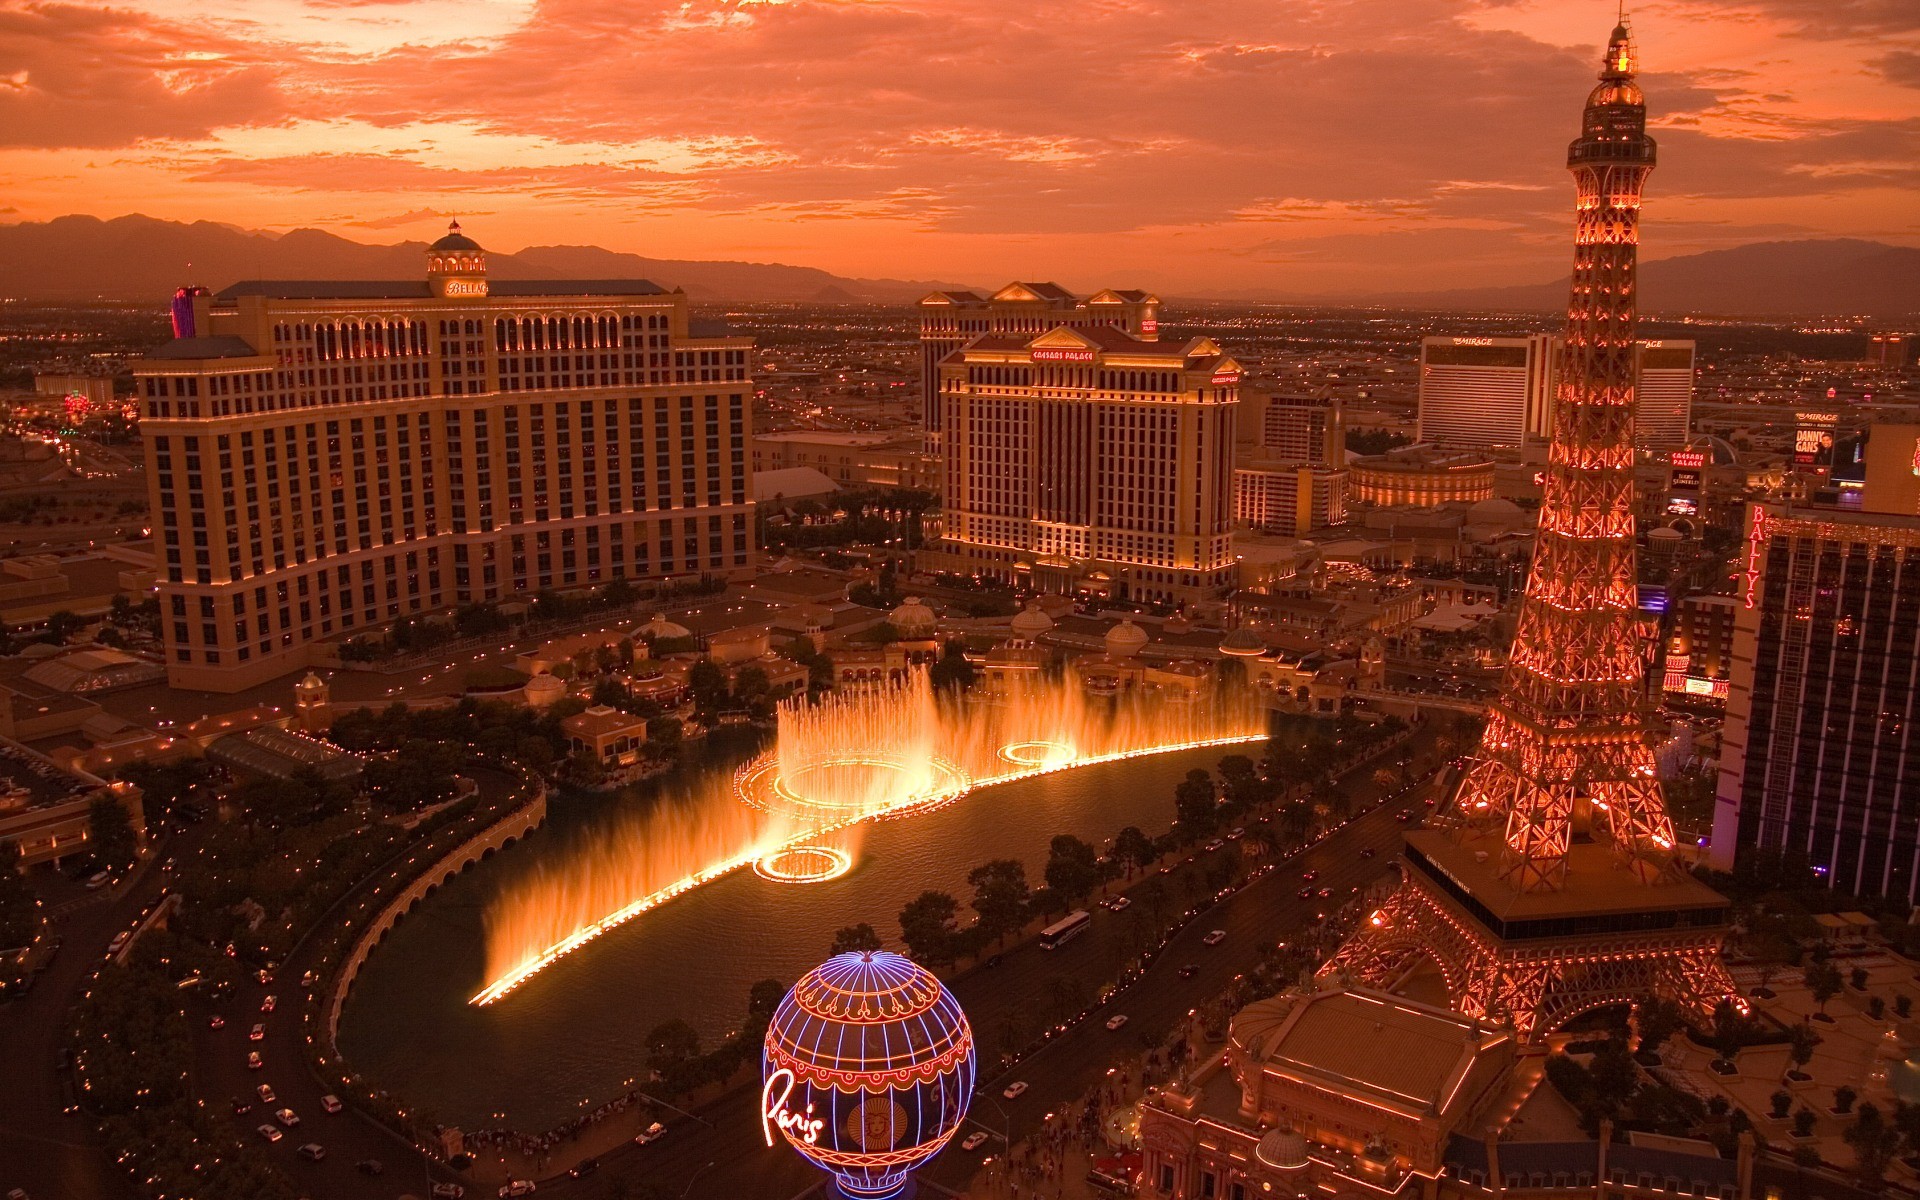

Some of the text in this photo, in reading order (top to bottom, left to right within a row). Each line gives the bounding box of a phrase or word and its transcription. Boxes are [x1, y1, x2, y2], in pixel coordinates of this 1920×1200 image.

[1457, 337, 1492, 346] MIRAGE
[1033, 352, 1093, 360] CAESARS PALACE
[1799, 413, 1838, 421] MIRAGE
[1796, 430, 1825, 442] DANNY
[1795, 441, 1819, 453] GANS
[1672, 452, 1704, 460] CAESARS
[1673, 459, 1702, 467] PALACE
[762, 1068, 824, 1147] Paris
